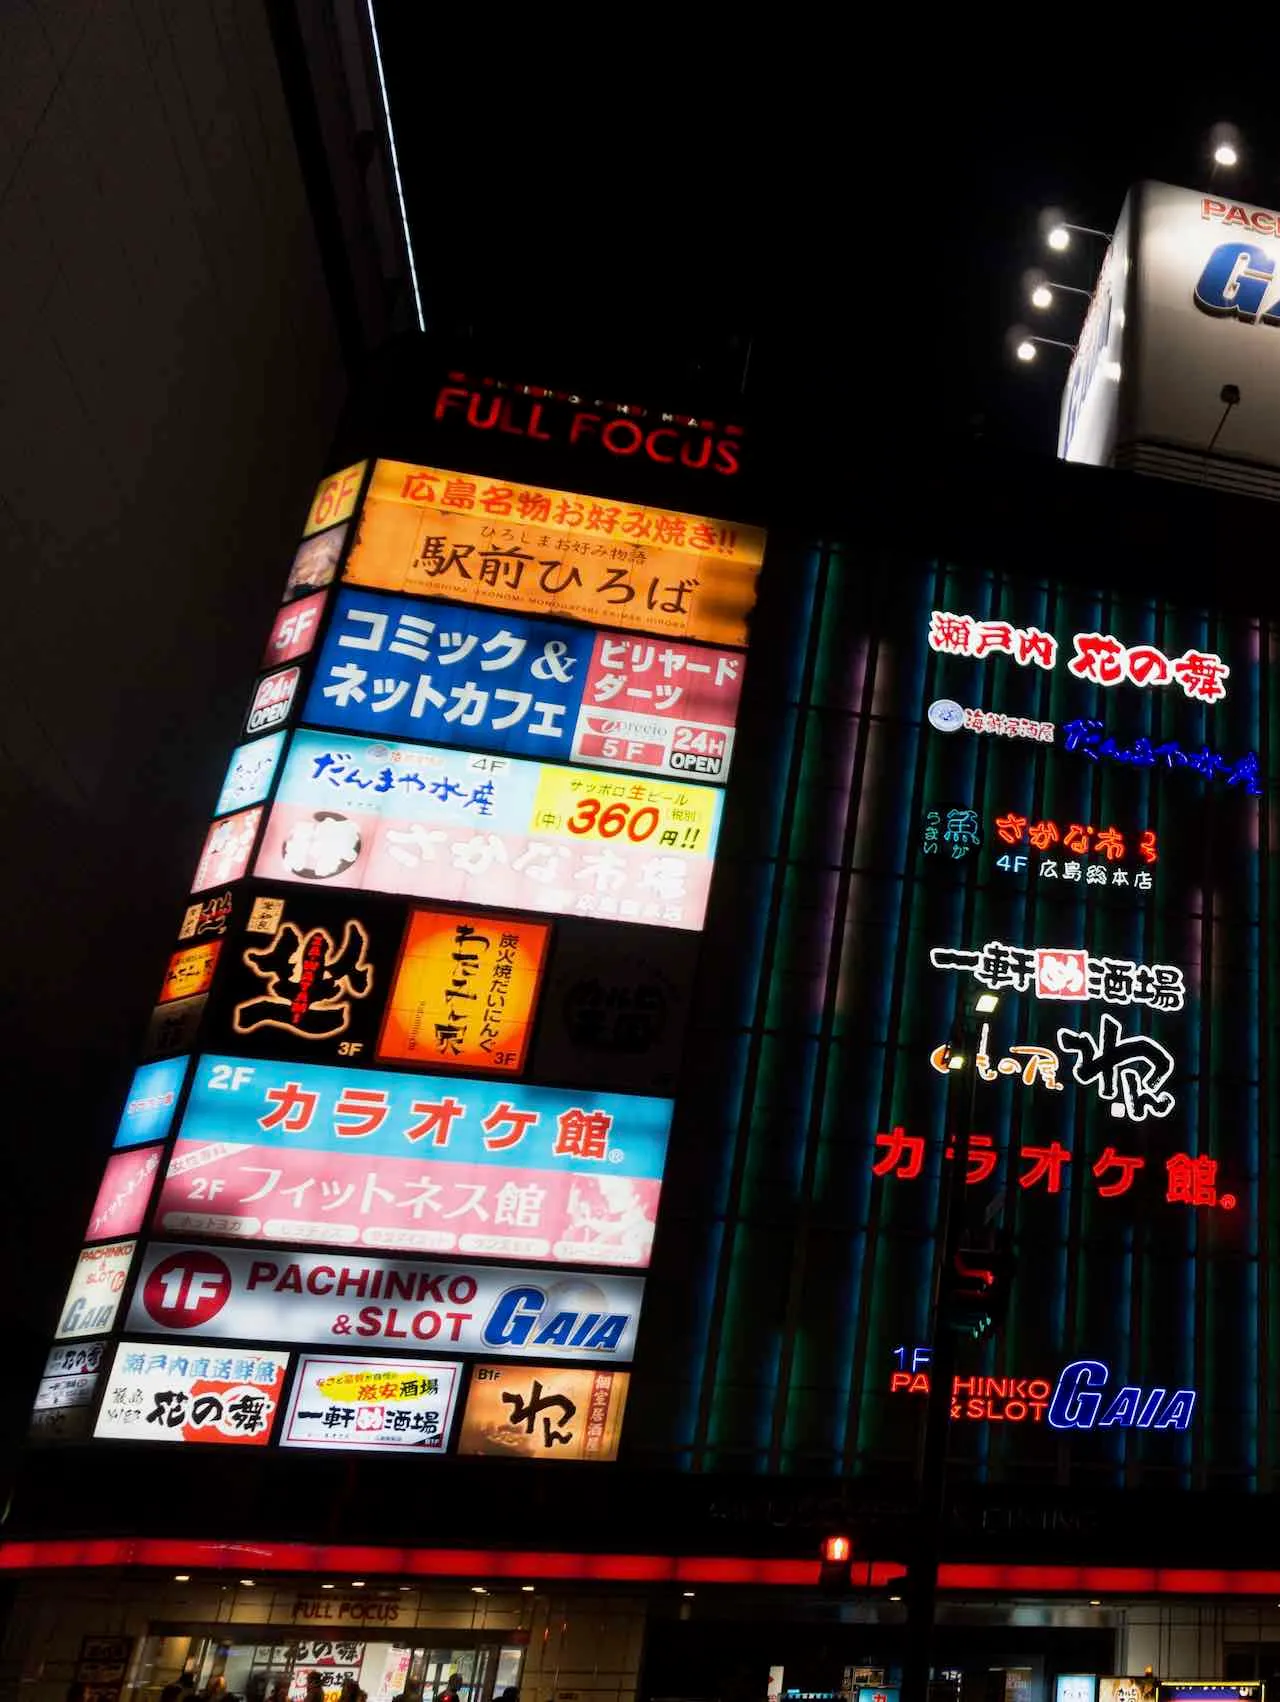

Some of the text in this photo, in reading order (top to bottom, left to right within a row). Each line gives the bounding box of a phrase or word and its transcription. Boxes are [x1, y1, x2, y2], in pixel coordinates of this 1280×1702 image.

[433, 386, 742, 476] FULL FOCUS
[315, 468, 360, 525] 6F
[400, 471, 738, 556] 広島名物お好み焼き!!
[411, 535, 701, 616] 駅前ひろば
[275, 607, 318, 650] 5F
[337, 607, 578, 685] コミック &
[598, 638, 740, 688] ビリヤード
[929, 611, 1231, 704] 瀬戸内 花の舞
[323, 662, 568, 739] ネットカフェ
[592, 676, 686, 711] ダーツ
[670, 751, 722, 777] OPEN
[673, 726, 727, 756] 24H
[311, 751, 498, 818] だんまや水産
[471, 757, 509, 775] 4F
[569, 776, 690, 806] サッポロ生ビール
[566, 798, 661, 844] 360
[995, 854, 1154, 890] 4F 広島総本店
[479, 930, 521, 1054] 炭火焼だいにんぐ
[930, 941, 1186, 1012] 一軒め酒場
[336, 1041, 365, 1057] 3F
[492, 1051, 518, 1067] 3F
[207, 1064, 256, 1093] 2F
[256, 1080, 614, 1161] カラオケ館
[871, 1125, 1219, 1208] カラオケ館
[187, 1176, 226, 1202] 2F
[236, 1164, 549, 1229] フィットネス館
[158, 1261, 479, 1320] 1F PACHINKO
[62, 1297, 115, 1333] GAIA
[481, 1283, 635, 1351] GAIA
[122, 1351, 277, 1383] 瀬戸内直送鮮魚
[477, 1368, 502, 1381] B1F
[893, 1346, 931, 1374] 1F
[146, 1385, 276, 1433] 花の舞
[890, 1373, 1050, 1400] PAHINKO
[1048, 1360, 1197, 1430] GAIA
[297, 1405, 441, 1434] 一軒め酒場
[501, 1379, 577, 1448] わん
[292, 1601, 400, 1621] FULL FOCUS
